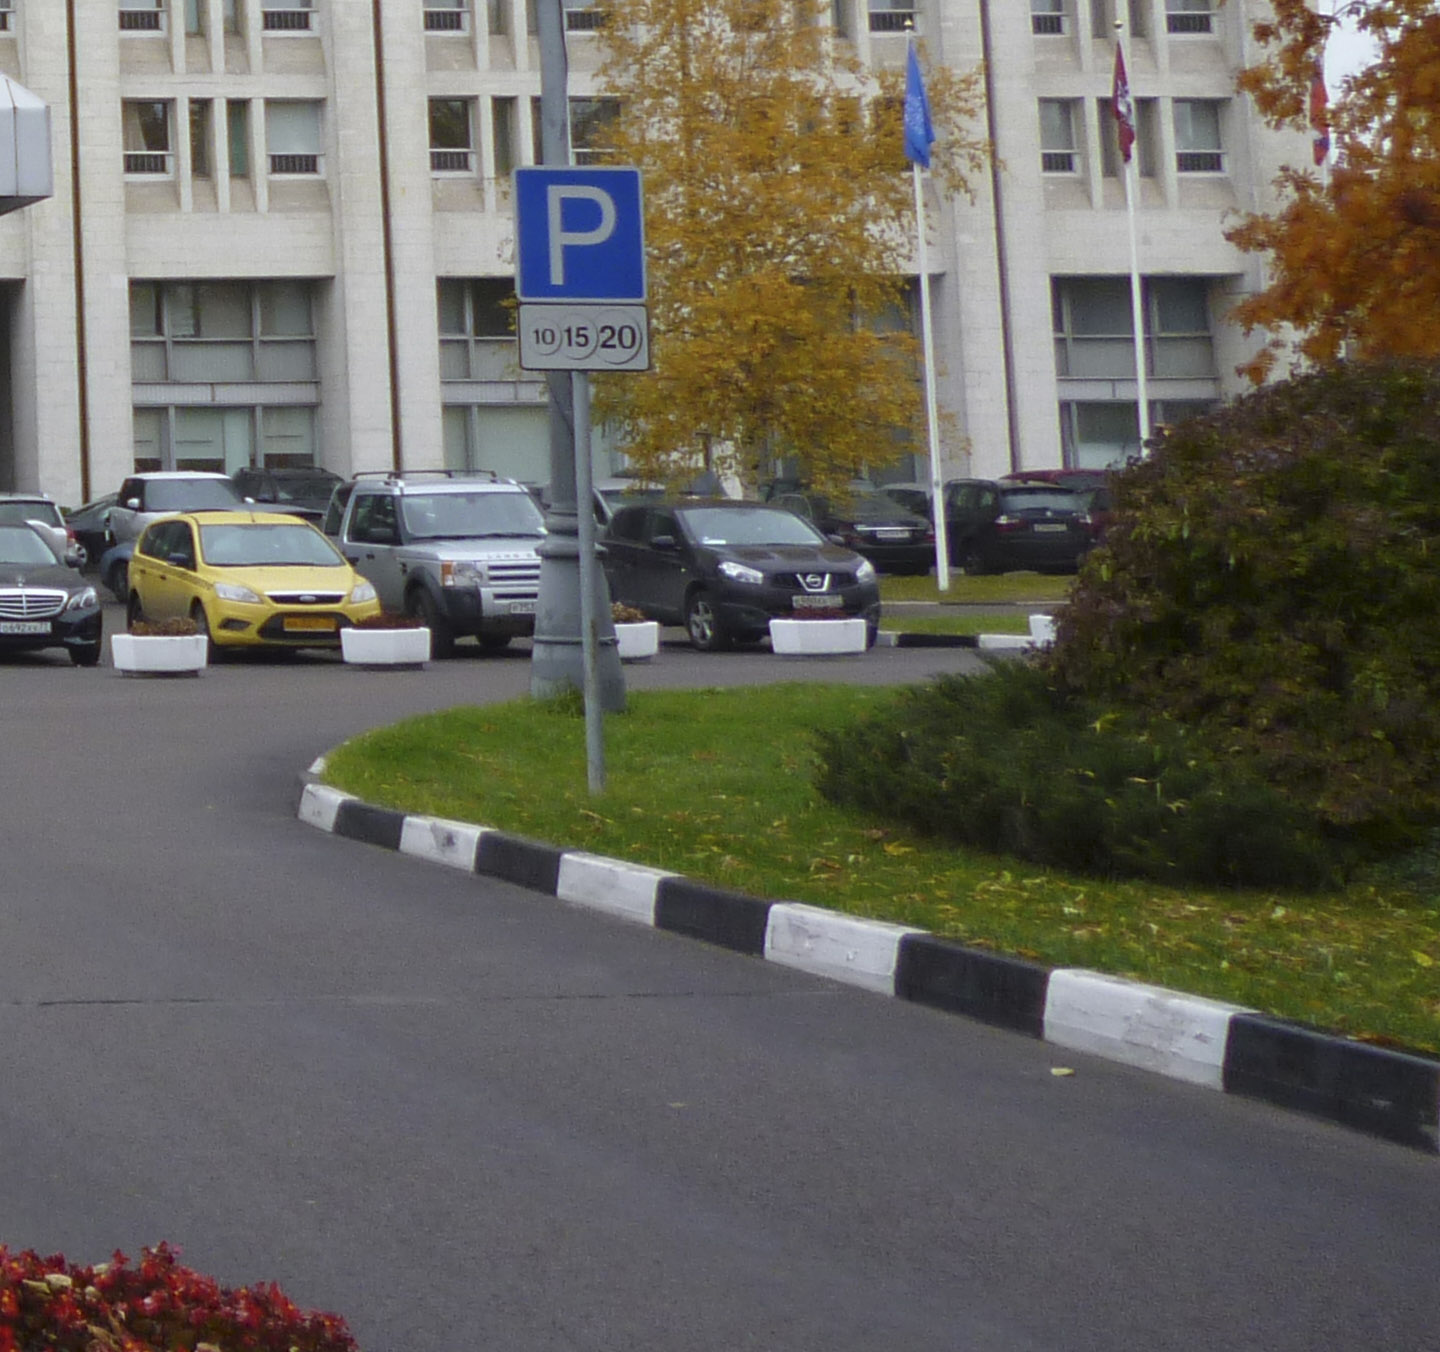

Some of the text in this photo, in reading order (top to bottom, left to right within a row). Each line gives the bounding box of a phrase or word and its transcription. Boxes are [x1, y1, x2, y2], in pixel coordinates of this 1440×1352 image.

[547, 185, 616, 286] P
[532, 325, 637, 349] 10 15 20
